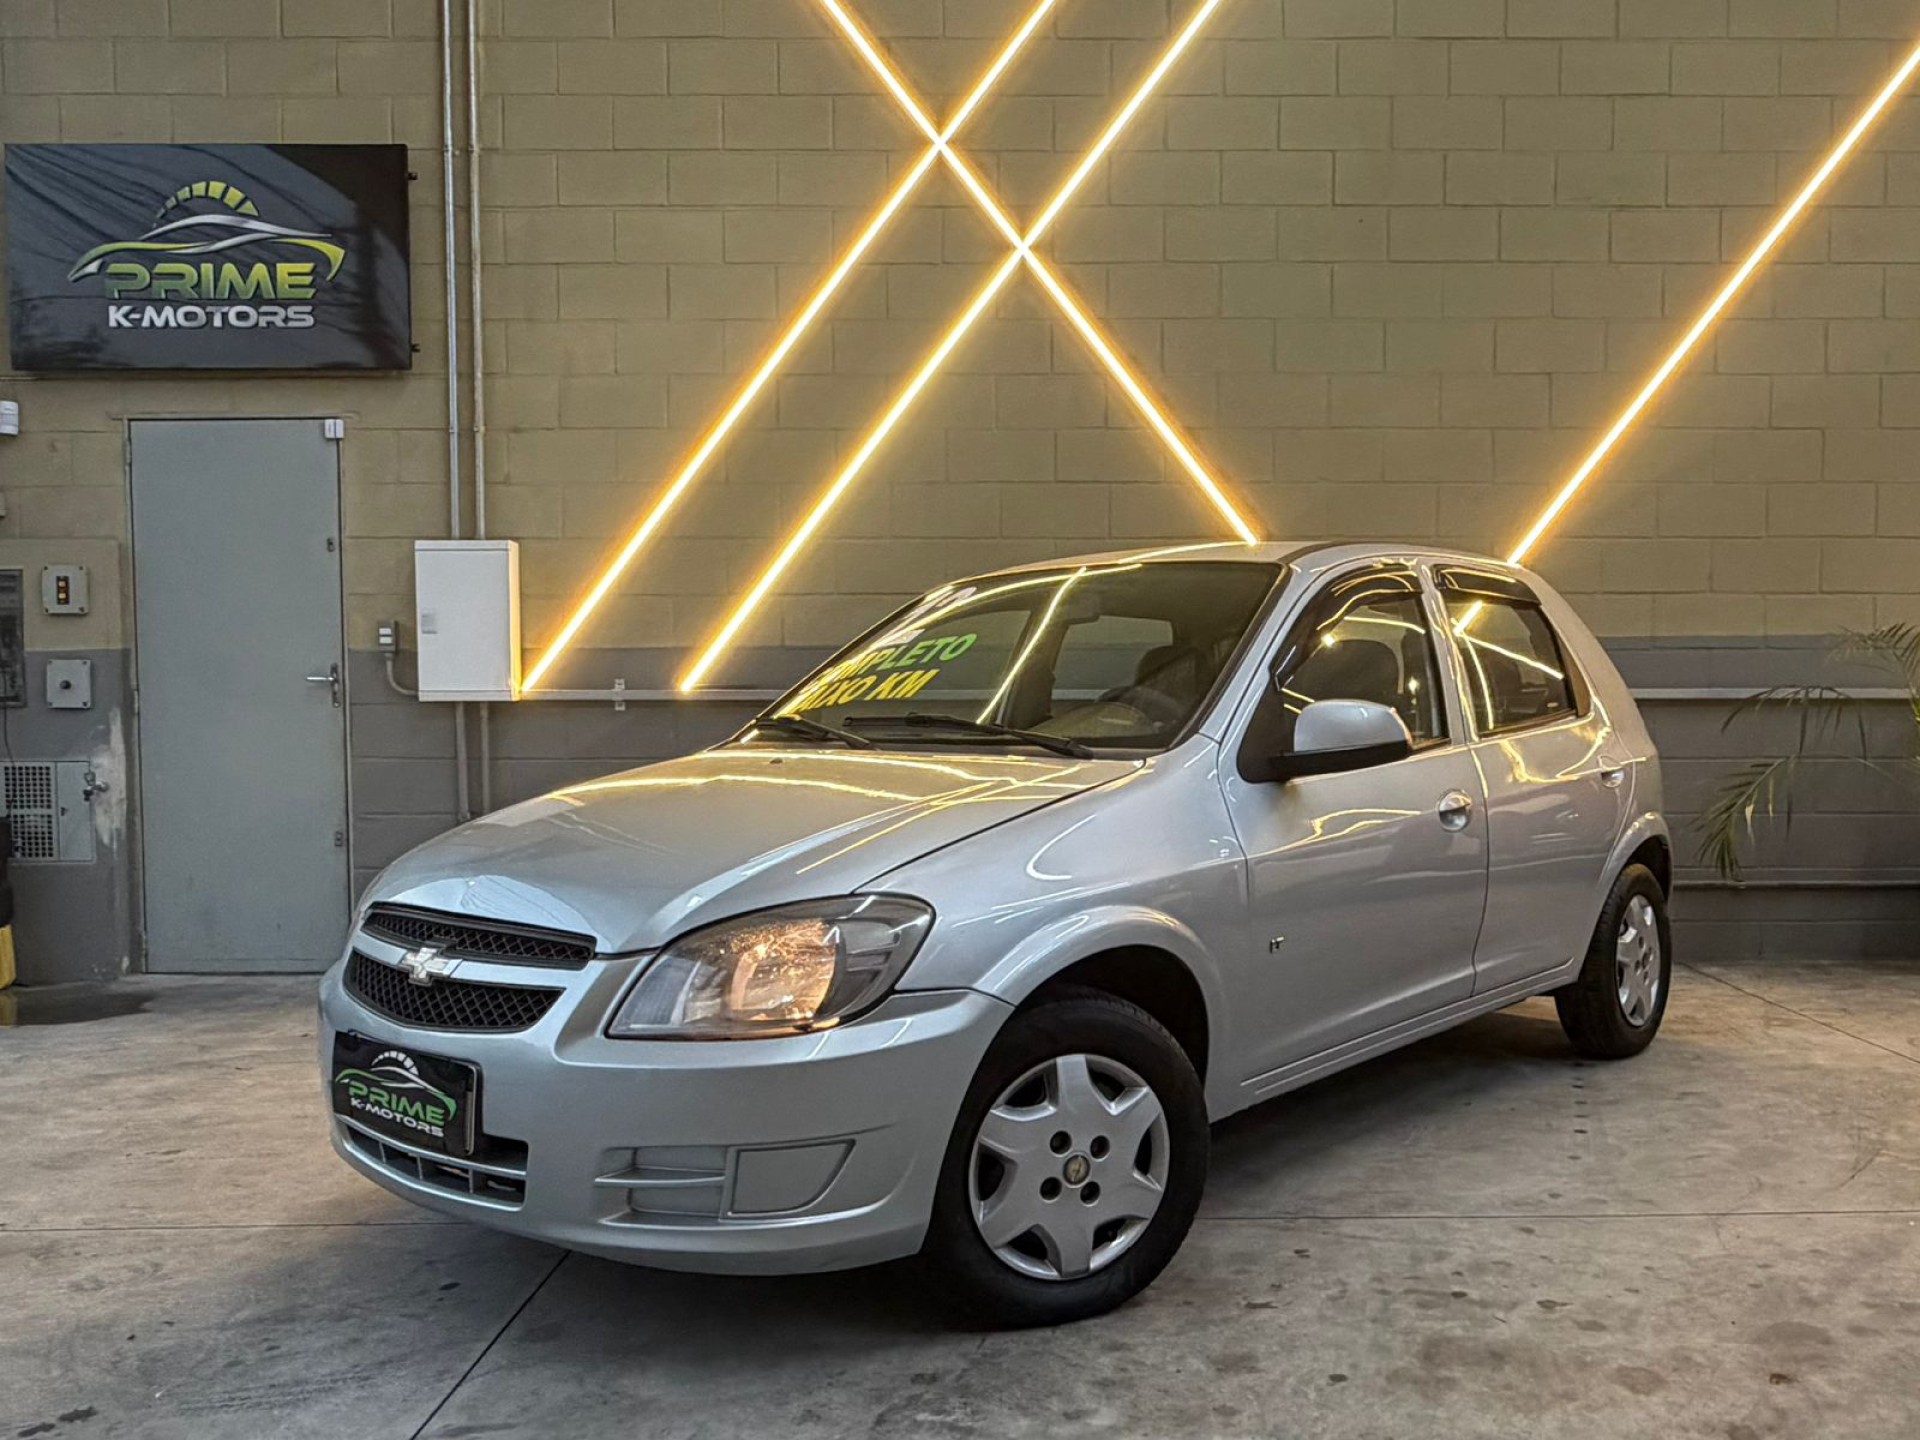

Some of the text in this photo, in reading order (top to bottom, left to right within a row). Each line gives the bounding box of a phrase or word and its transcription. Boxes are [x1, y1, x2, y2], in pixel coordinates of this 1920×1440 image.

[105, 262, 317, 299] PRIME
[108, 305, 315, 329] K-MOTORS
[864, 668, 940, 701] KM
[348, 1080, 445, 1126] PRIME
[350, 1097, 444, 1138] K-MOTORS
